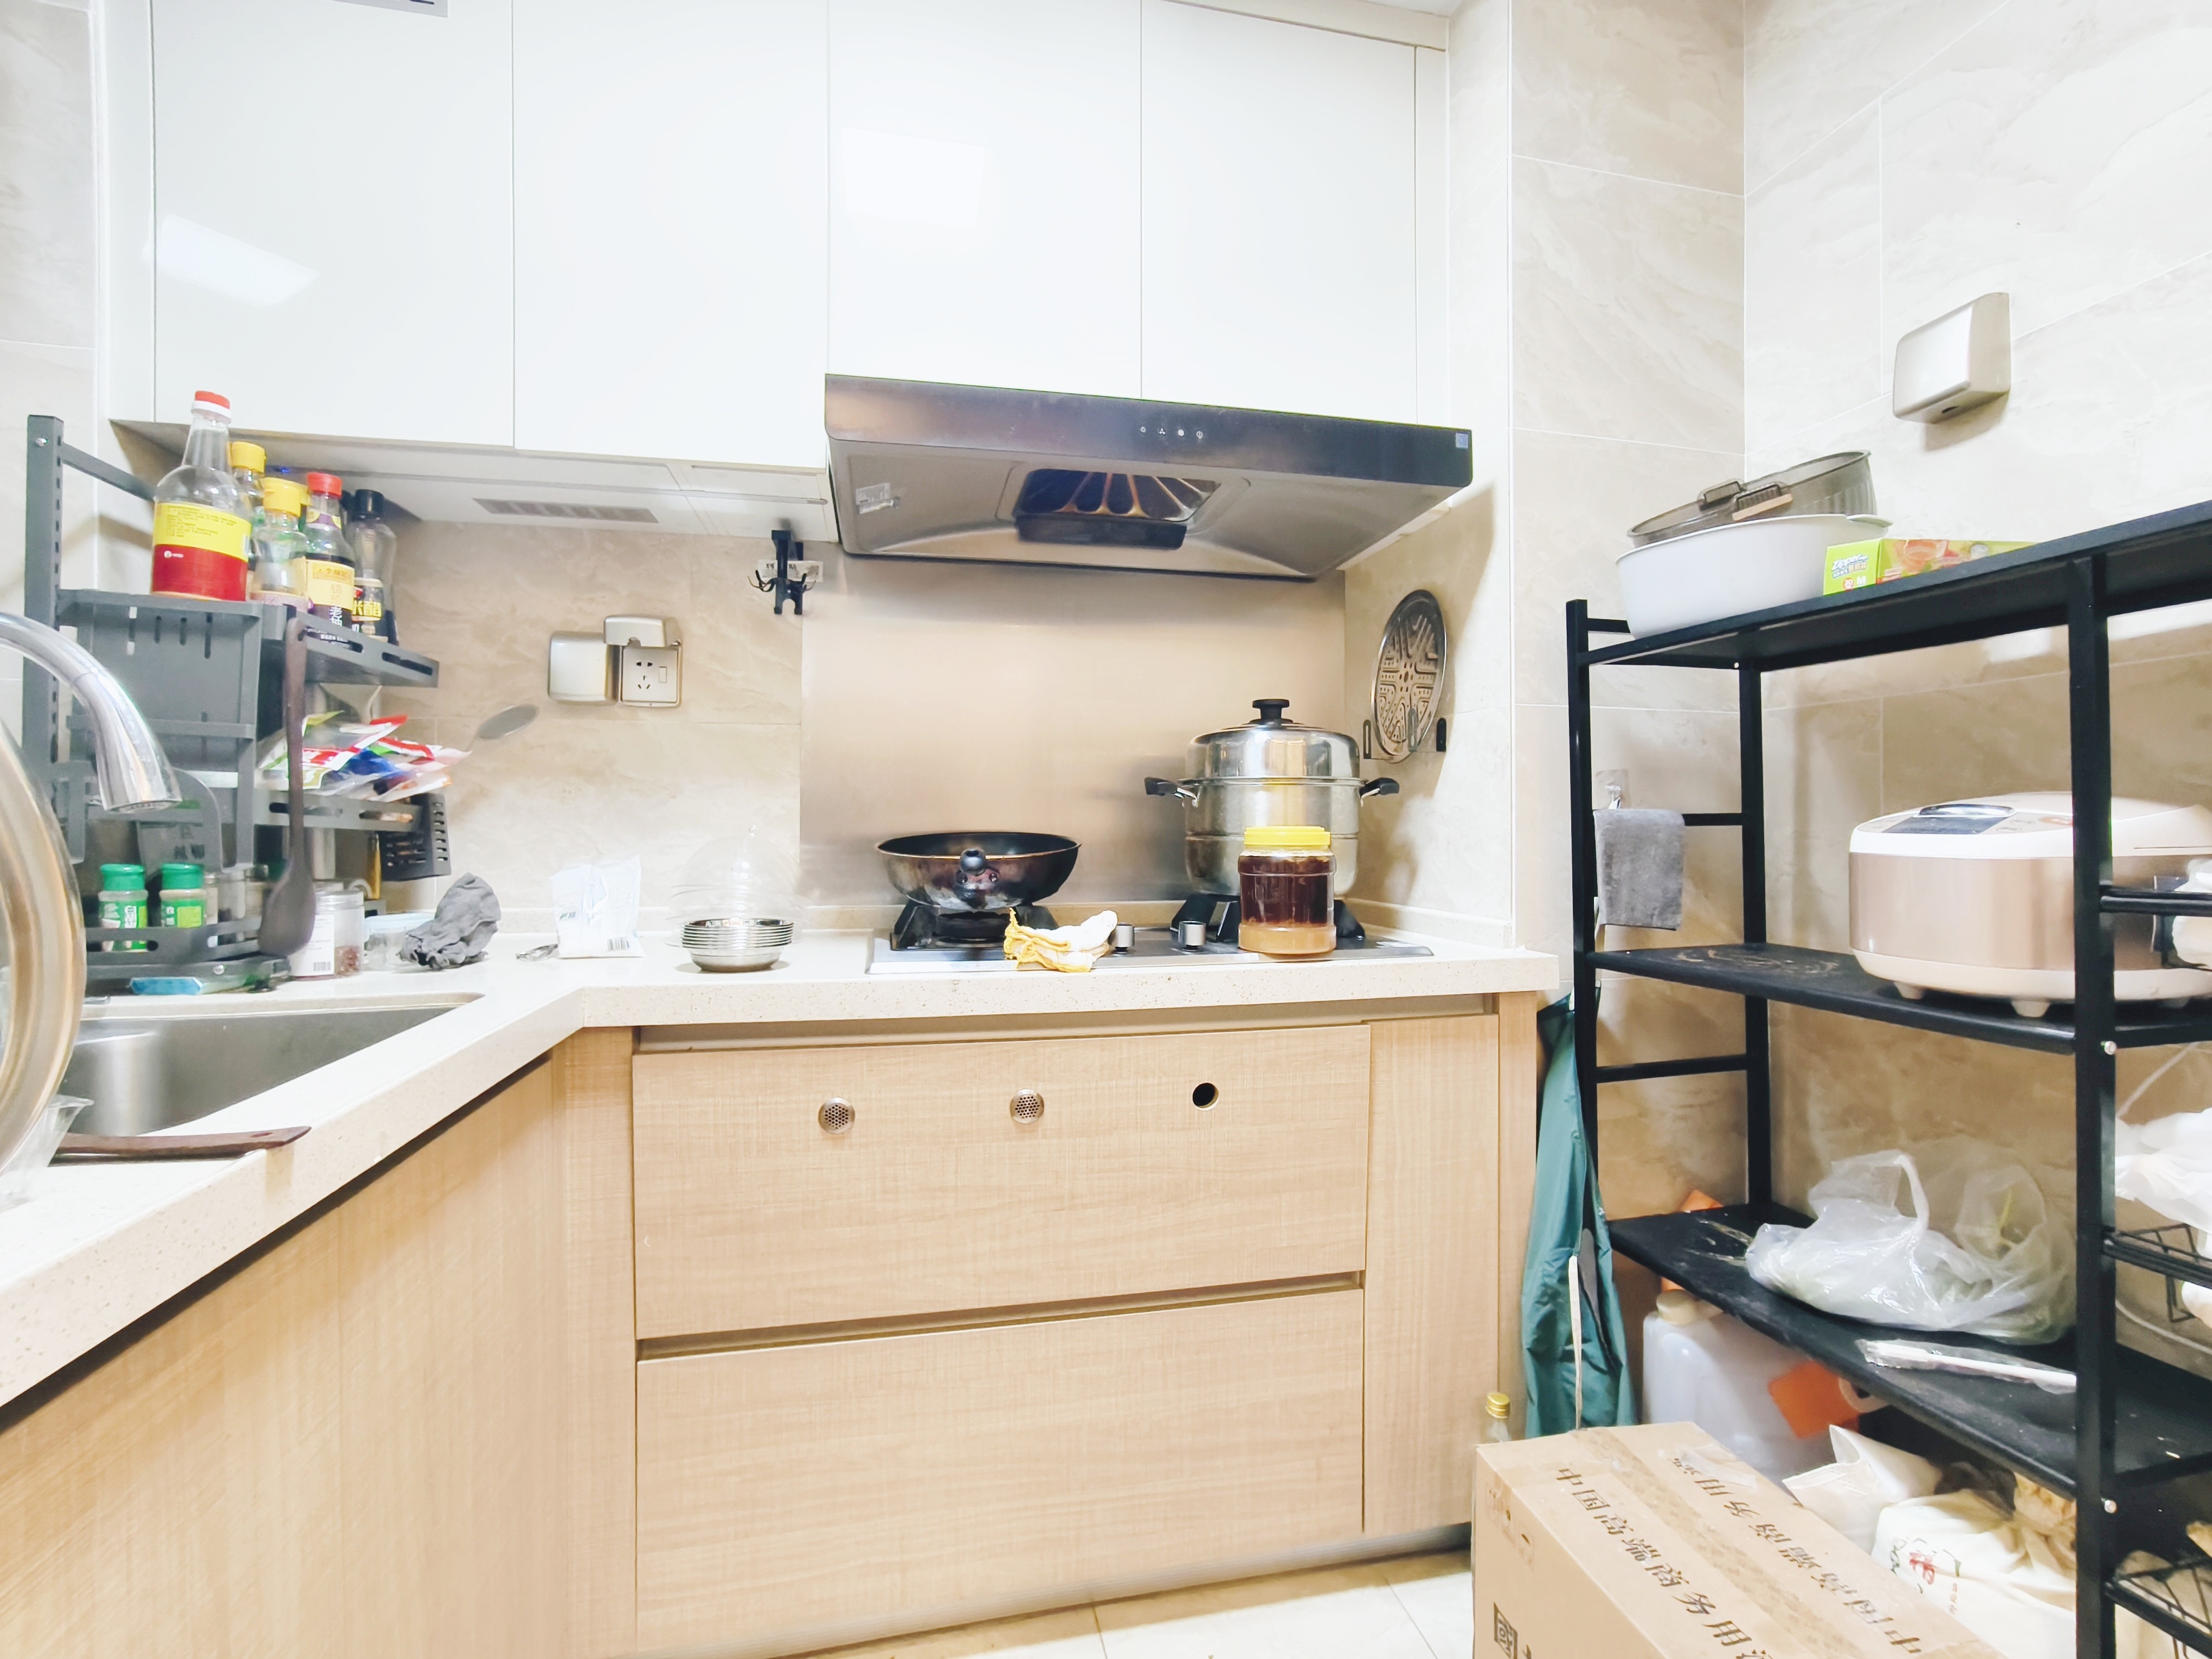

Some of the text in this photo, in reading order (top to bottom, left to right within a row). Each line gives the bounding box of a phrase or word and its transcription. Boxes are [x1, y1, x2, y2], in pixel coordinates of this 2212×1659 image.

[1832, 554, 1860, 570] Zipper
[1556, 1468, 1772, 1659] 中国高端商务用
